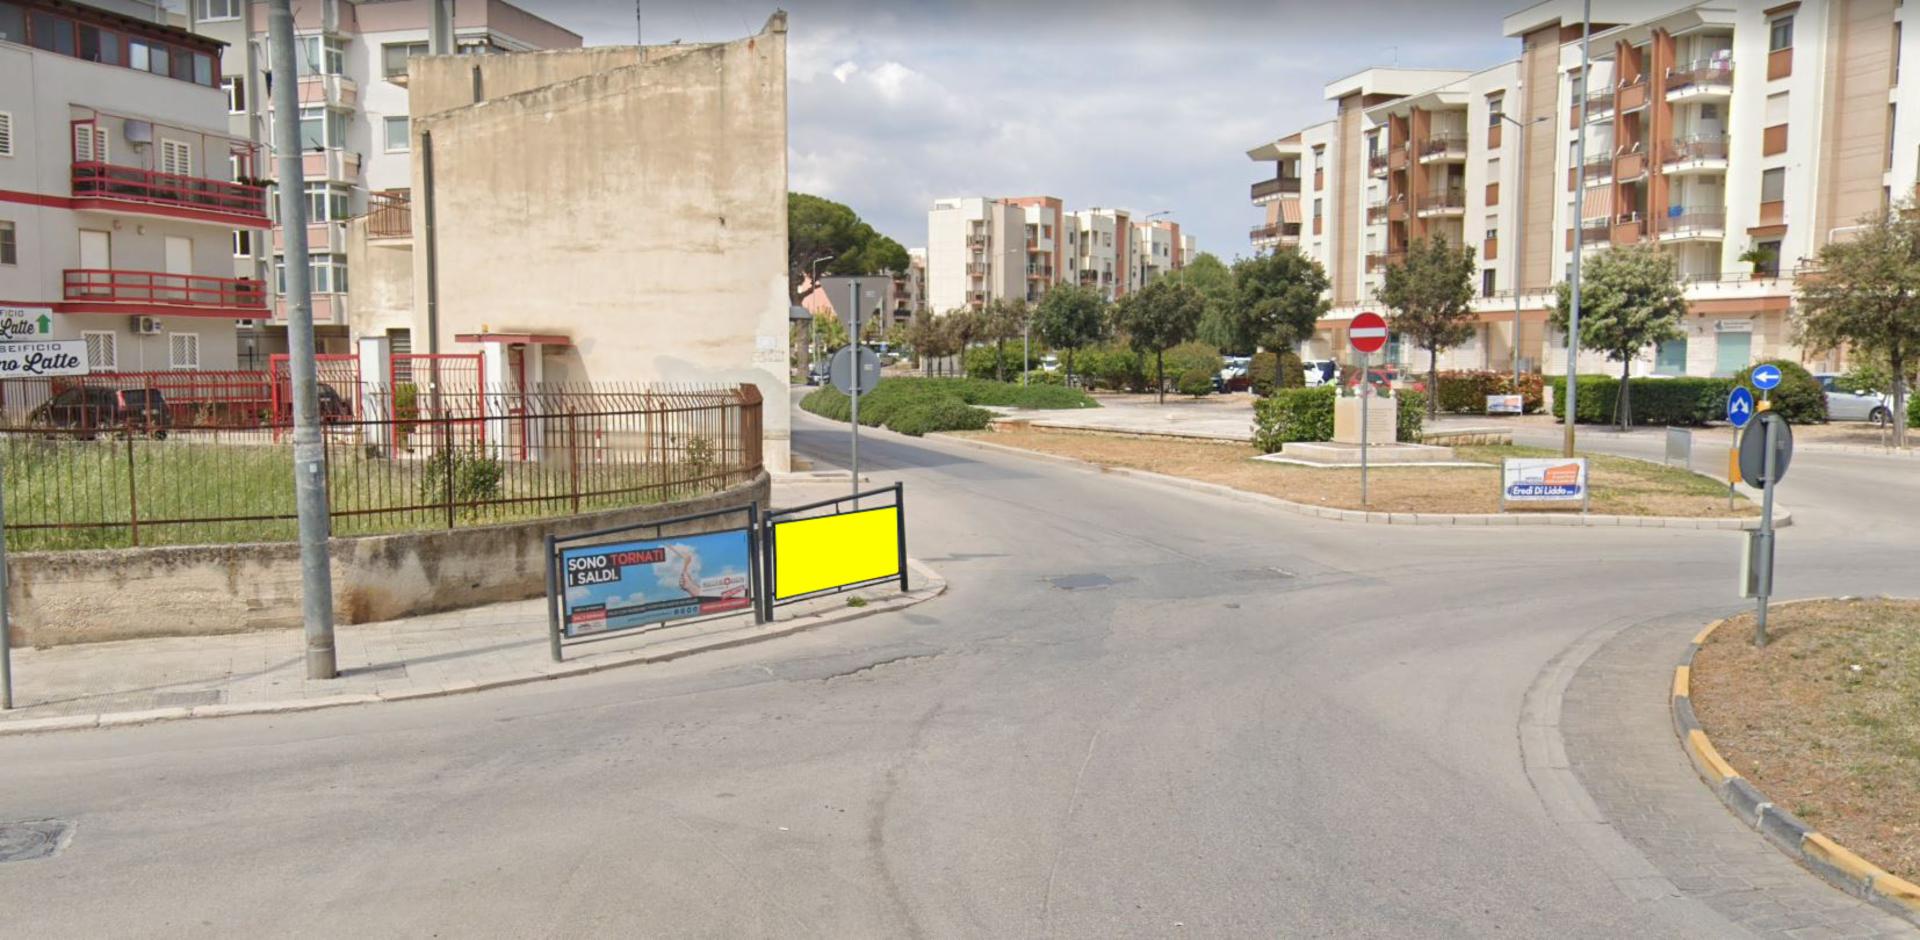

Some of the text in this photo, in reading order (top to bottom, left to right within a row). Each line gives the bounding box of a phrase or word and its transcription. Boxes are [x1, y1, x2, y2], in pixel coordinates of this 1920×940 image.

[0, 318, 34, 339] Latte
[22, 352, 80, 374] Latte
[568, 549, 665, 571] SONO TORNATI
[569, 569, 619, 586] I SALDI.
